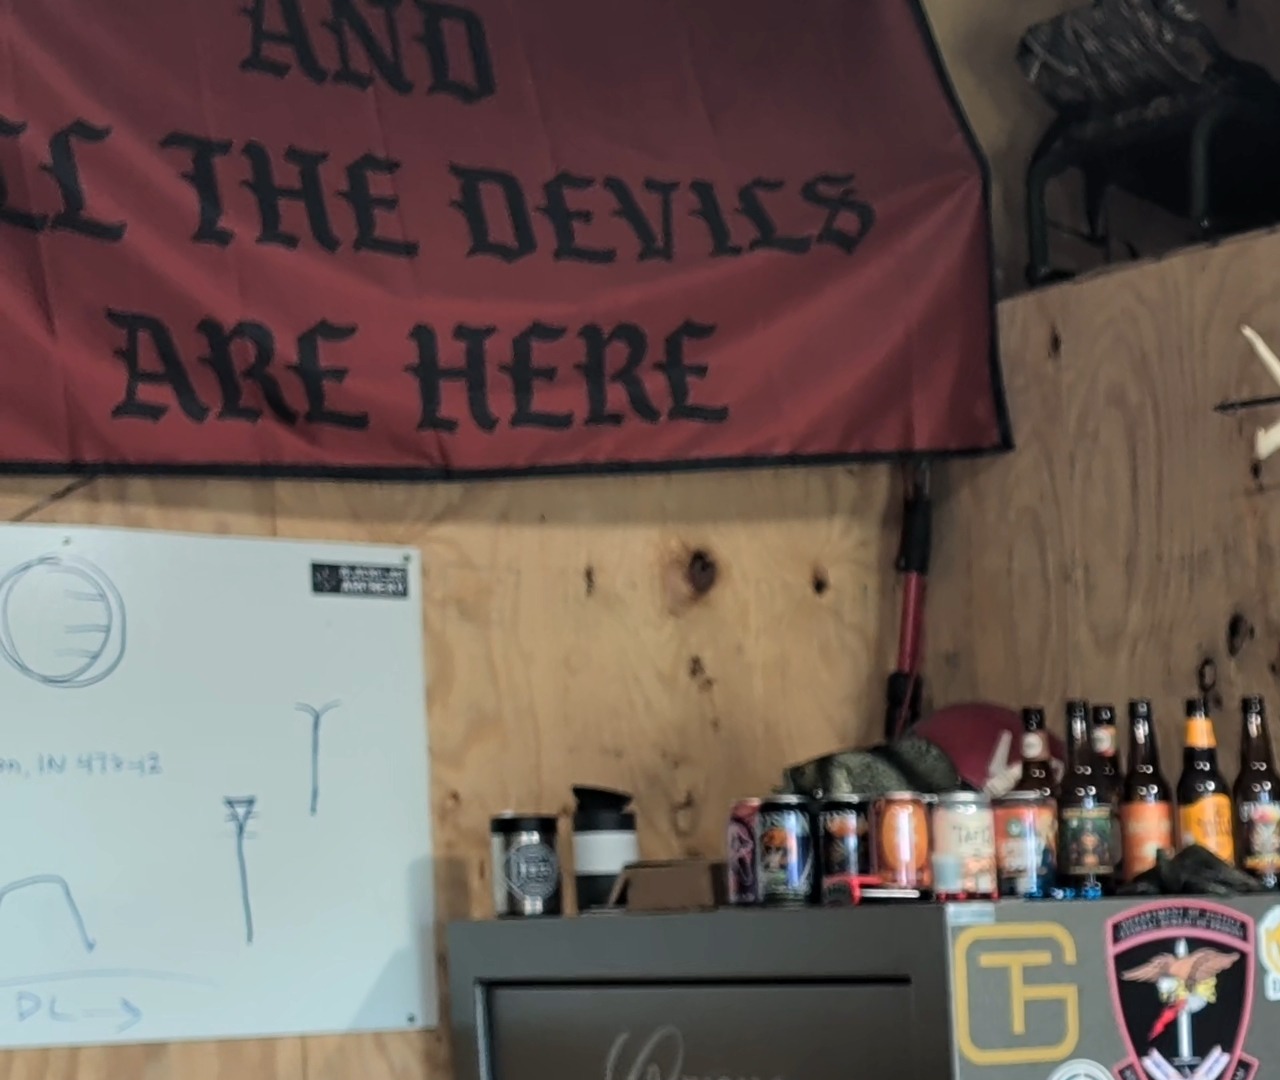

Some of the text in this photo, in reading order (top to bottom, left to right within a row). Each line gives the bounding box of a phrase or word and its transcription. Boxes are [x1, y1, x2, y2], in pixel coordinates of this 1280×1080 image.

[238, 0, 497, 104] AND
[160, 132, 420, 260] THE
[450, 163, 876, 264] DEVILS
[105, 308, 729, 433] ARE HERE
